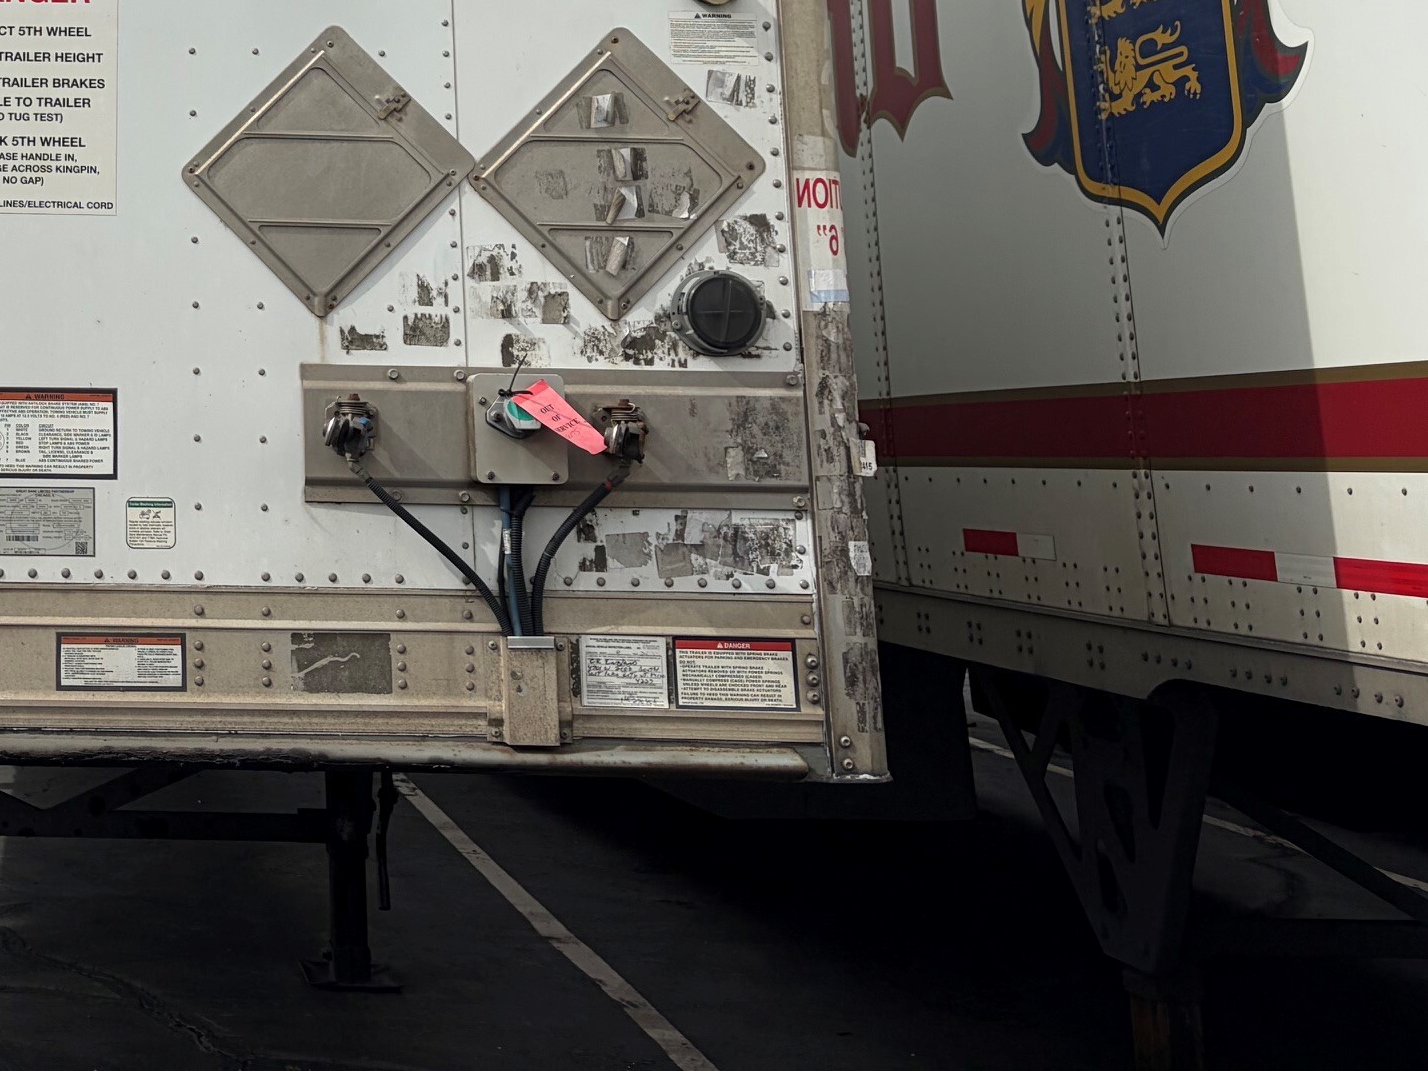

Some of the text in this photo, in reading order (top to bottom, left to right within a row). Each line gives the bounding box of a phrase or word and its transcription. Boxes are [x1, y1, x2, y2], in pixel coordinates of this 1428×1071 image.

[18, 25, 42, 37] 5TH
[46, 26, 92, 37] WHEEL
[54, 51, 103, 63] HEIGHT
[52, 77, 106, 89] BRAKES
[16, 96, 32, 108] TO
[37, 97, 91, 109] TRAILER
[8, 112, 30, 123] TUG
[33, 112, 64, 124] TEST)
[11, 136, 36, 147] 5TH
[39, 136, 86, 148] WHEEL
[20, 152, 61, 163] HANDLE
[64, 152, 77, 163] IN,
[10, 164, 52, 175] ACROSS
[55, 164, 100, 176] KINGPIN,
[2, 176, 44, 187] NO GAP)
[86, 201, 114, 210] CORD
[540, 404, 555, 414] OUT
[551, 414, 562, 422] OF
